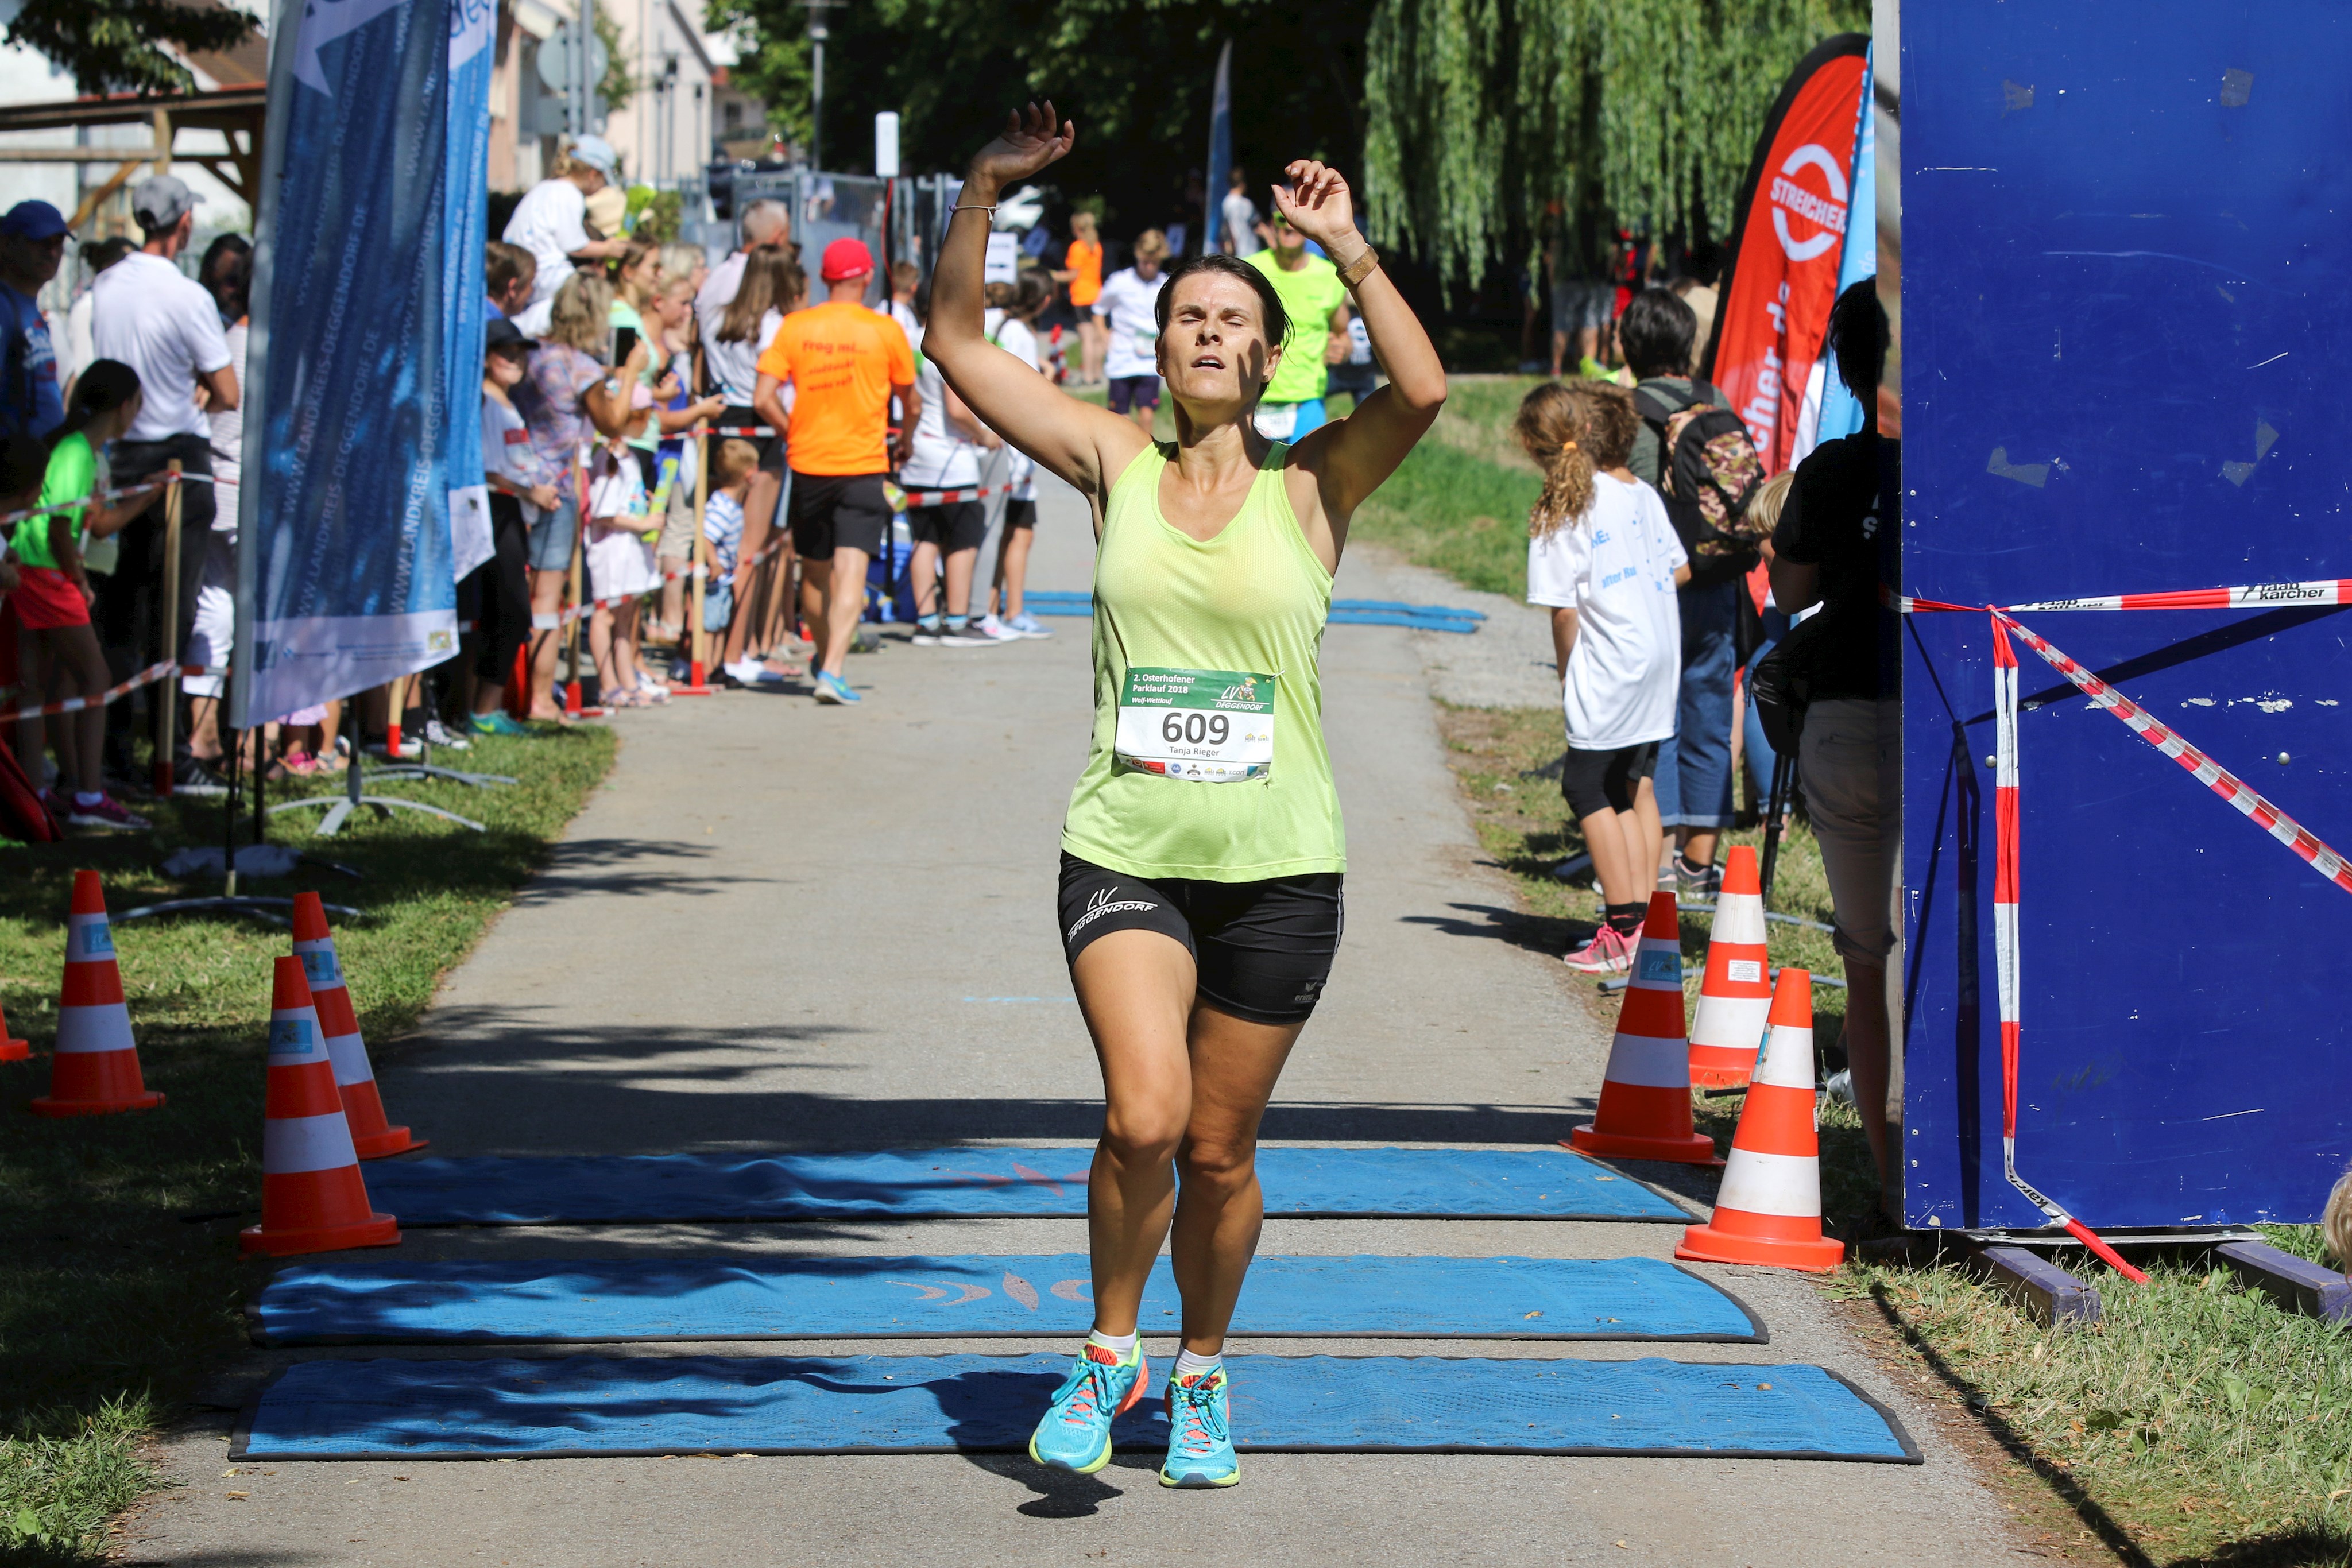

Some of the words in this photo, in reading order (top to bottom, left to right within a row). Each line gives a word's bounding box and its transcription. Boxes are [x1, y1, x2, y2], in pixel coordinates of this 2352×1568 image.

[280, 202, 370, 515] WWW.LANDKREIS-DEGGENDORF.DE
[2259, 588, 2325, 601] karcher
[1133, 674, 1141, 682] 2.
[1142, 673, 1196, 684] Osterhofener
[1132, 684, 1166, 694] Parklauf
[1167, 685, 1189, 694] 2018
[1221, 686, 1240, 700] LV
[1131, 696, 1173, 705] Wolf-Wettlauf
[1215, 702, 1264, 711] DEGGENDORF
[1162, 712, 1229, 745] 609
[1169, 746, 1191, 756] Tanja
[1193, 748, 1220, 757] Rieger
[1086, 886, 1119, 912] LV
[1069, 903, 1154, 943] DEGGENDORF
